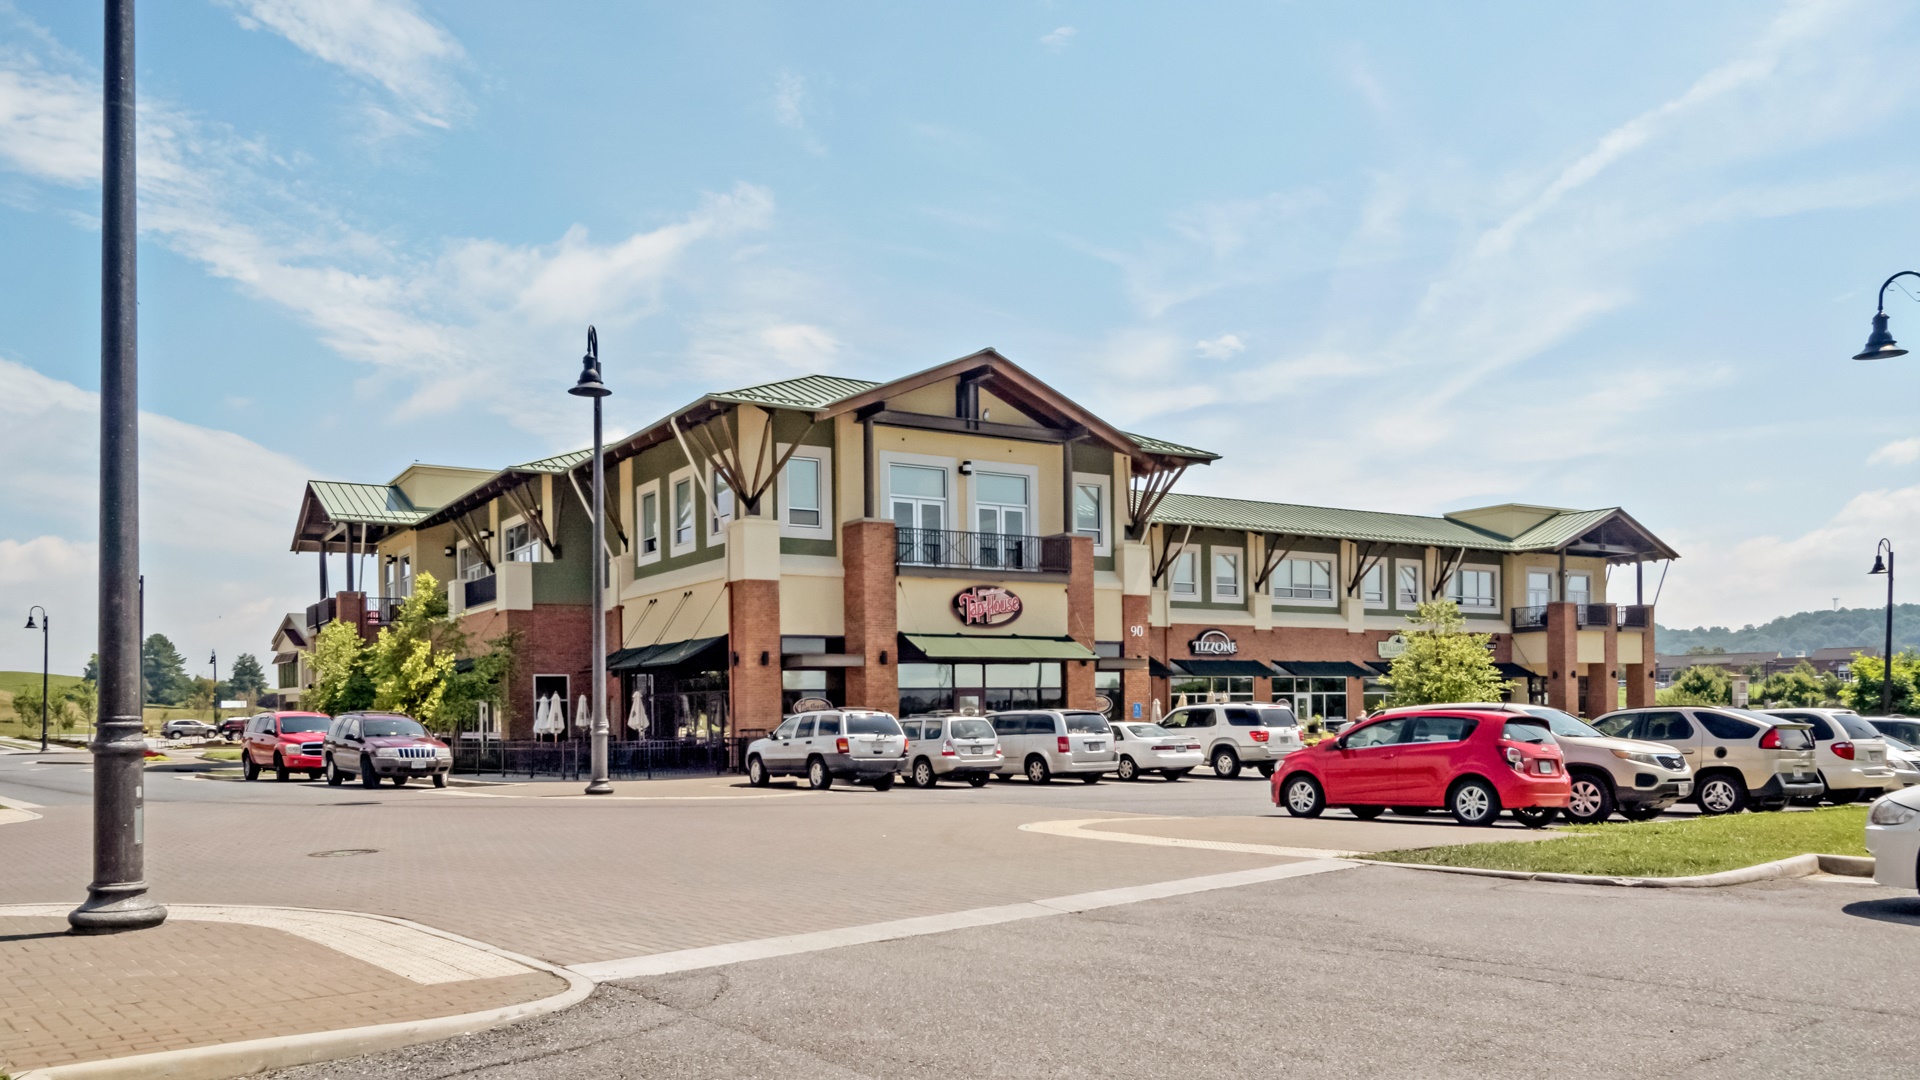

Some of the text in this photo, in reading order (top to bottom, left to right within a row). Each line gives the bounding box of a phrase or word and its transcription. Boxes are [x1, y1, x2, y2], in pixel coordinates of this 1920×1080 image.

[959, 587, 1020, 625] Tap House
[1130, 625, 1143, 637] 90
[1192, 641, 1238, 654] TIZZONE
